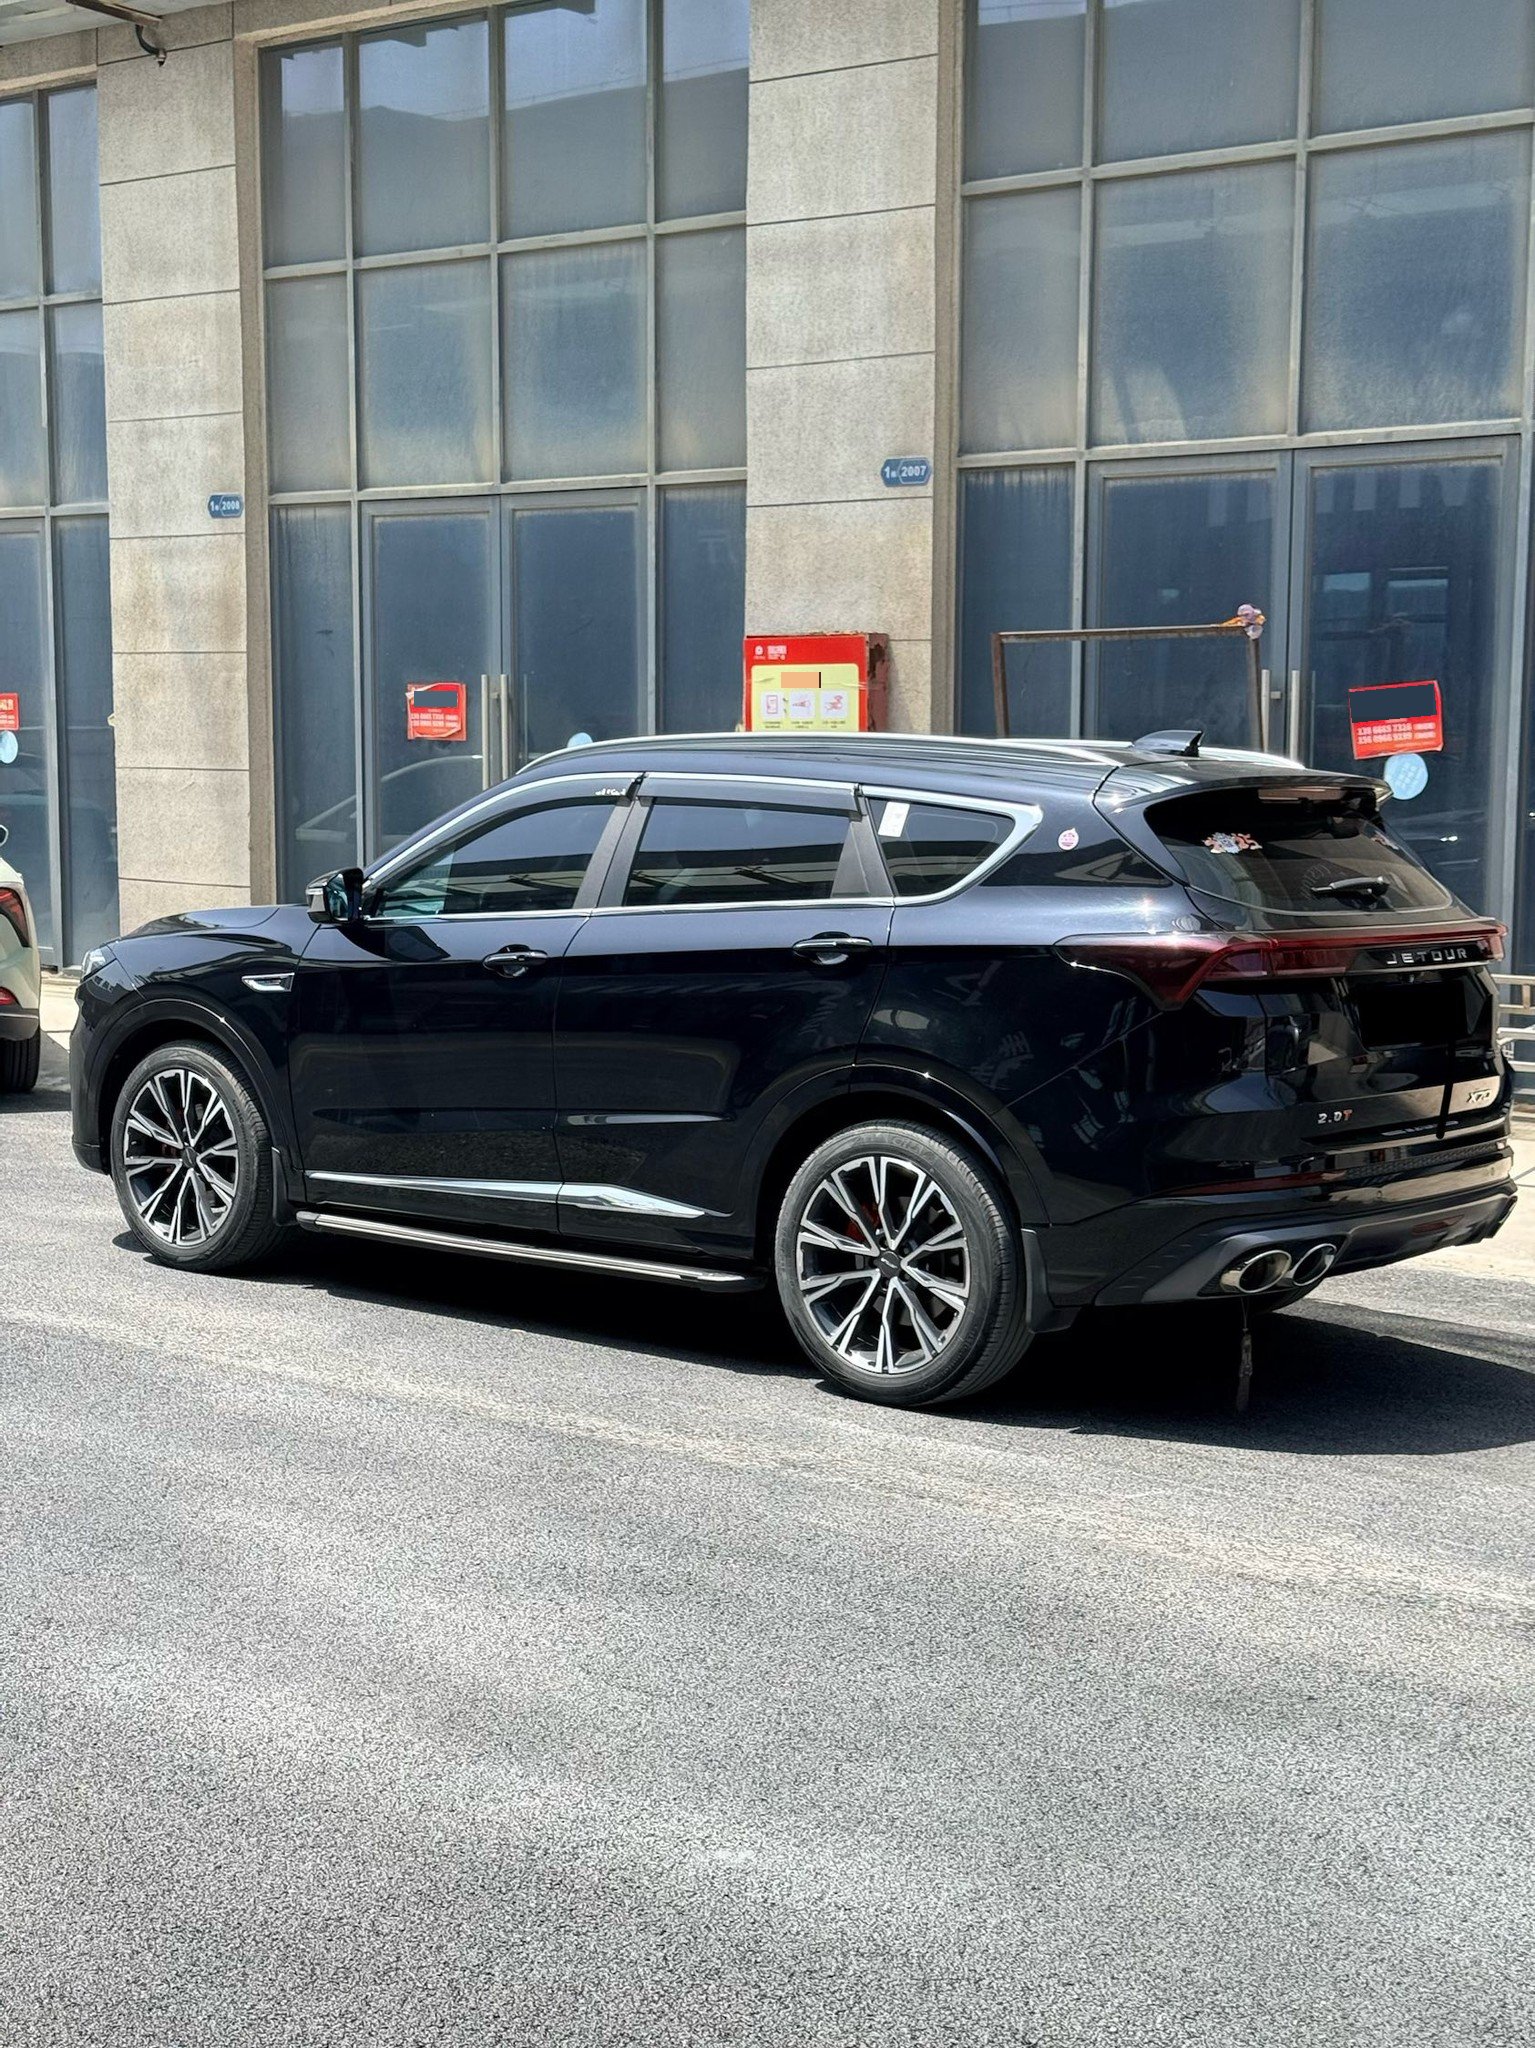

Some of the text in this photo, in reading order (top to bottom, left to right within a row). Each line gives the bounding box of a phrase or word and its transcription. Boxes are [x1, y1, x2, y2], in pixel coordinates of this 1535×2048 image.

[901, 465, 927, 477] 2007
[222, 500, 240, 510] 2008
[1386, 948, 1468, 965] JETOUR
[1317, 1109, 1353, 1124] 2.0T
